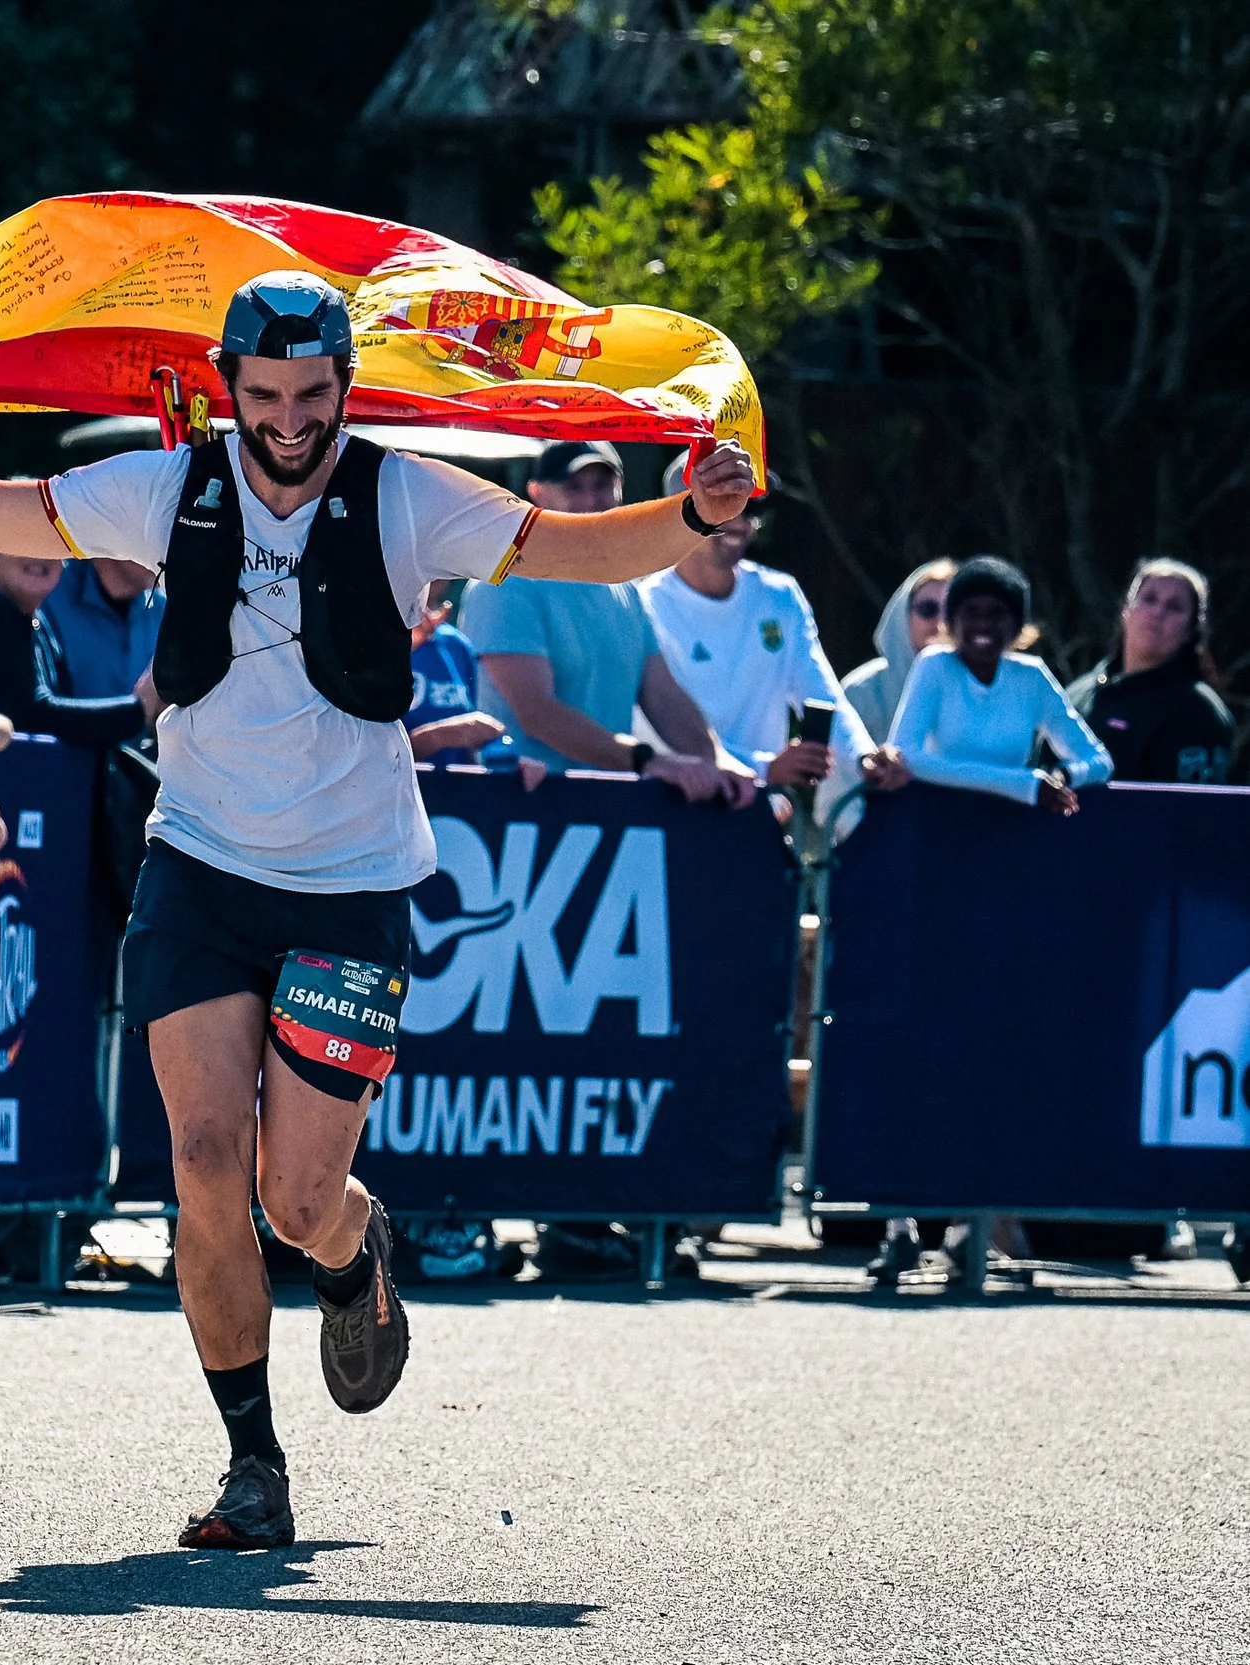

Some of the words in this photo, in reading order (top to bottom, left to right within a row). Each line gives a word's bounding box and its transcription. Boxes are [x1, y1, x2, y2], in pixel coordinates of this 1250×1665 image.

[178, 516, 217, 528] SALOMON
[398, 816, 673, 1036] OKA
[287, 986, 357, 1020] ISMAEL
[361, 1007, 396, 1034] FLTTR
[324, 1039, 352, 1062] 88
[570, 1076, 666, 1157] FLY
